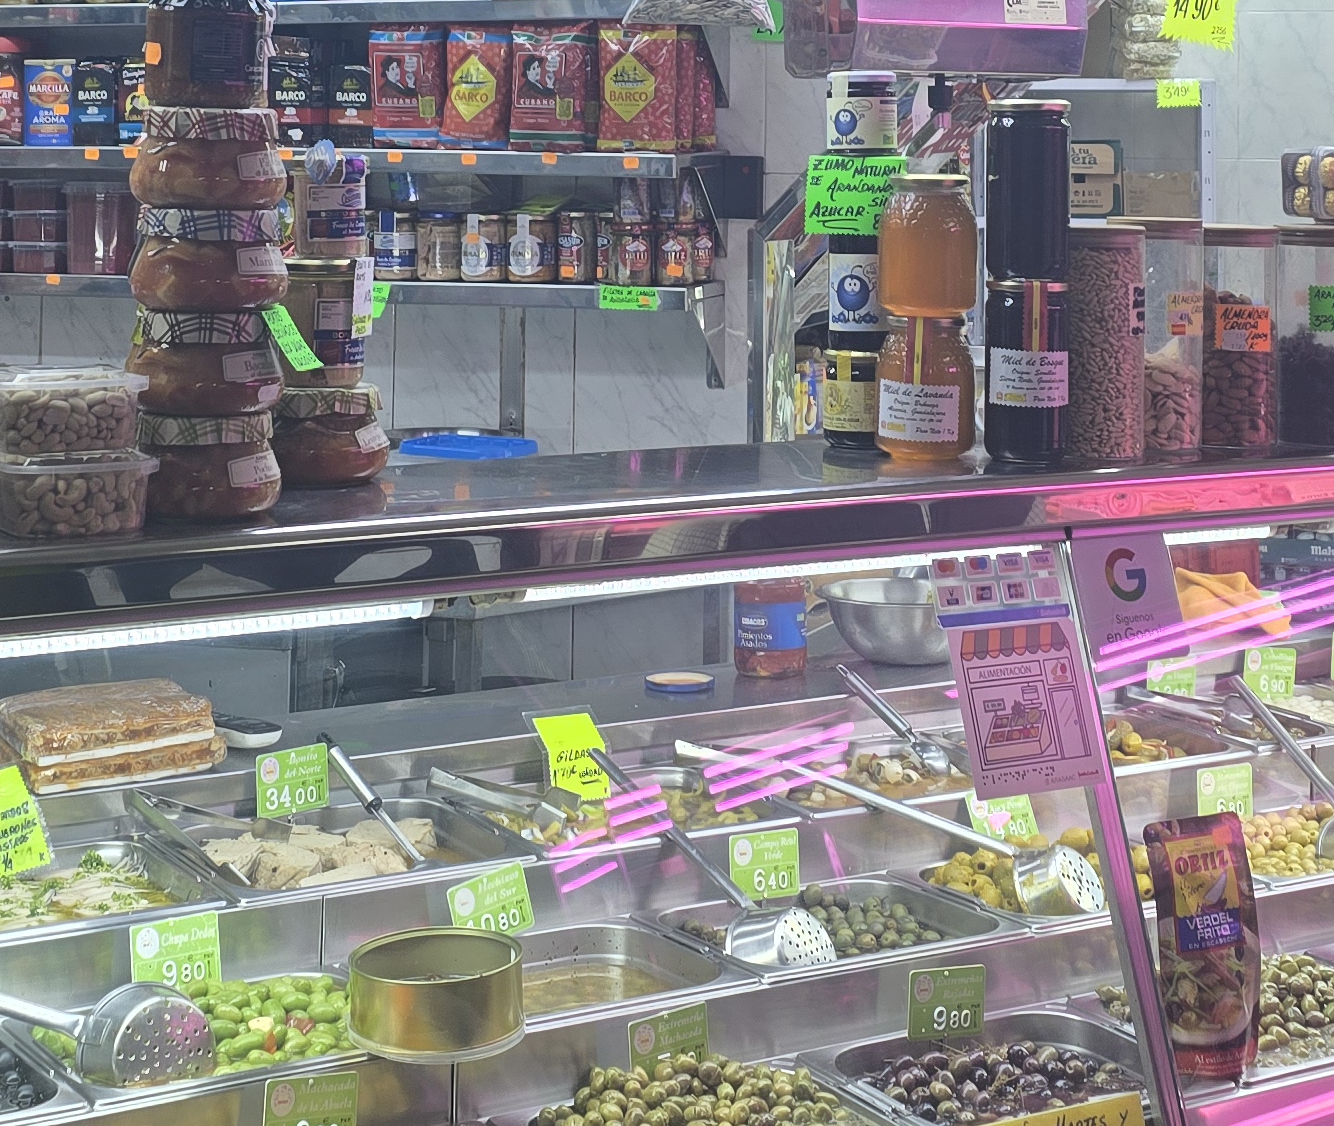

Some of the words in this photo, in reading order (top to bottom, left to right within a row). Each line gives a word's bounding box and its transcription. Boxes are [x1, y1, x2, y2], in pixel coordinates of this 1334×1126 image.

[28, 83, 70, 95] MARCILLA
[77, 89, 108, 101] BARCO
[275, 90, 305, 102] BARCO
[335, 91, 367, 103] BARCO
[453, 90, 489, 103] BARCO
[609, 90, 649, 103] BARCO
[32, 115, 66, 124] AROMA
[812, 158, 854, 173] ZUMO
[1000, 354, 1023, 366] Miel
[1025, 355, 1038, 366] de
[883, 384, 900, 396] Miel
[901, 386, 913, 396] de
[914, 388, 955, 400] Lavanda
[739, 638, 767, 650] Asados
[977, 664, 1033, 680] ALIMENTACIÓN
[556, 748, 591, 764] GILDAS
[300, 763, 323, 776] Norte
[1174, 849, 1229, 875] ORTIZ
[1186, 912, 1234, 930] VERDEL
[1196, 924, 1231, 941] FRITO
